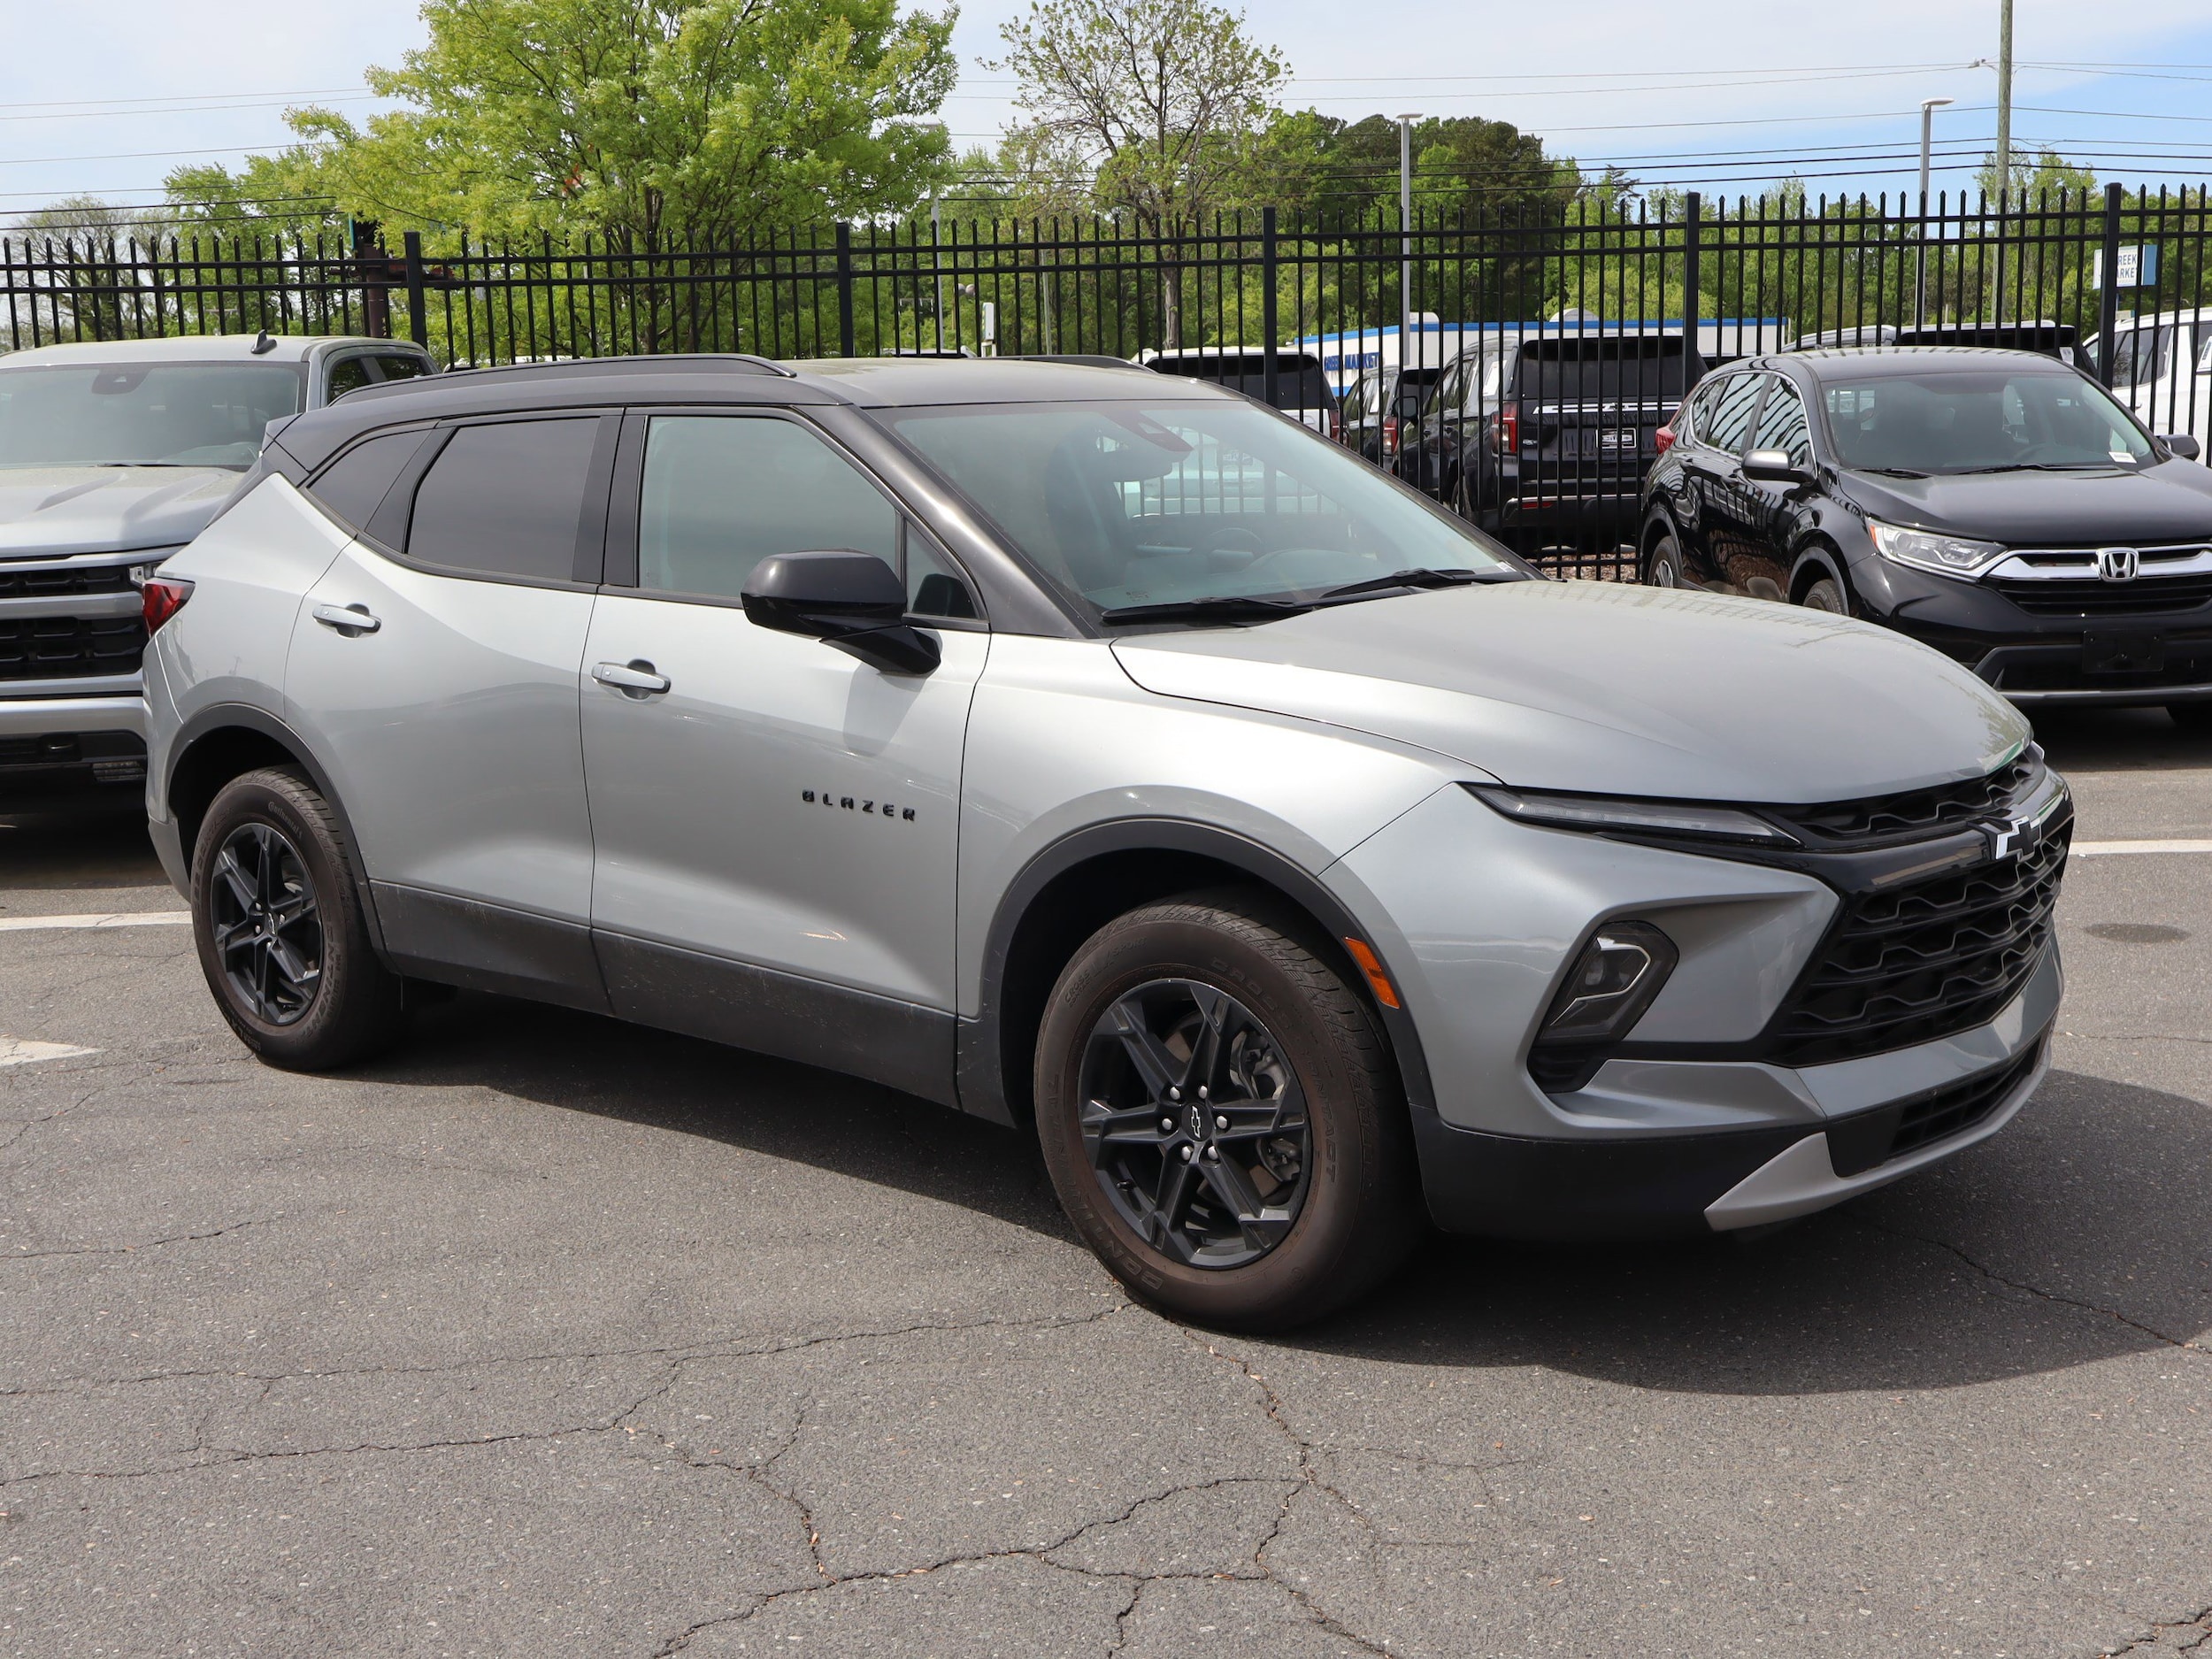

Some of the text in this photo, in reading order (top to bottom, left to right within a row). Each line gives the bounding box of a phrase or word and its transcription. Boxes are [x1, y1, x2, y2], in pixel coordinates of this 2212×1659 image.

[2117, 254, 2137, 265] REEK
[2116, 267, 2138, 279] ARKE
[1325, 355, 1342, 372] GREE
[802, 789, 916, 822] BLAZER
